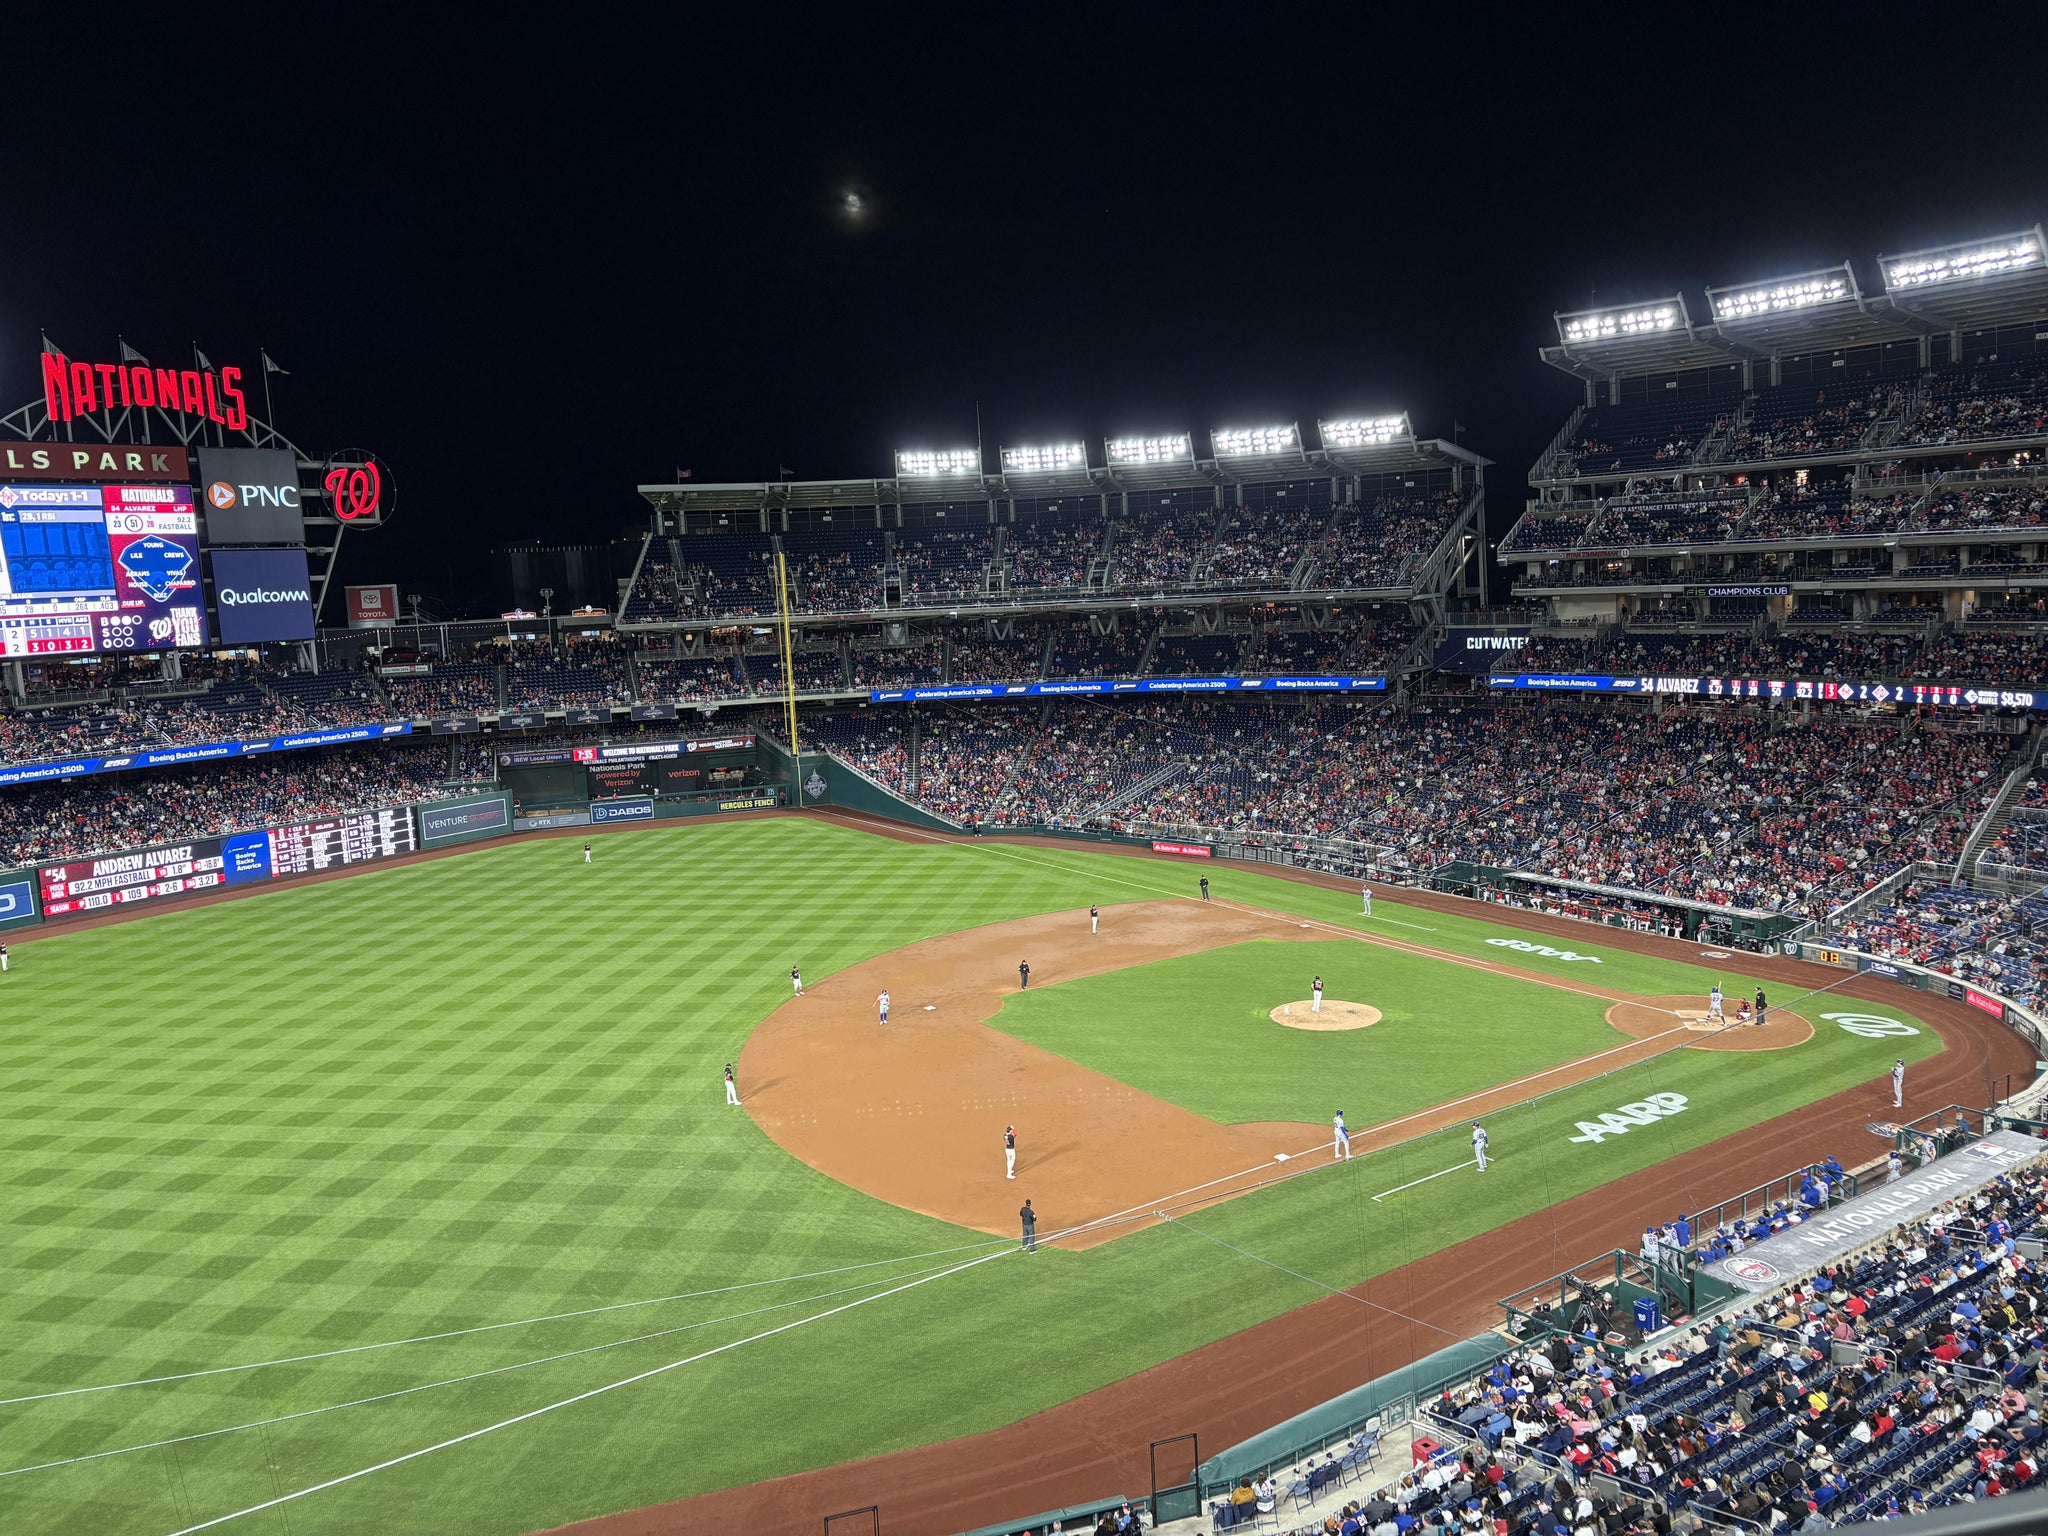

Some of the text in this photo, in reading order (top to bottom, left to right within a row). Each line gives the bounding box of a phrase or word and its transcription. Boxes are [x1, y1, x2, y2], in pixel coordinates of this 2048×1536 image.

[41, 352, 247, 430] NATIONALS
[72, 451, 170, 473] PARK
[20, 490, 88, 503] Today: 1-1
[121, 488, 175, 503] NATIONALS
[238, 485, 299, 508] PNC
[113, 520, 121, 528] 23
[130, 519, 138, 527] 51
[1708, 587, 1761, 596] CHAMPIONS
[1762, 586, 1788, 595] CLUB
[220, 588, 309, 606] Qualcomm
[100, 617, 109, 626] B
[30, 629, 37, 638] 5
[46, 628, 52, 637] 1
[63, 627, 70, 636] 4
[80, 627, 86, 635] 1
[102, 628, 110, 637] S
[13, 639, 88, 652] 2 3 0 3 2
[1466, 636, 1529, 650] CUTWATE
[1149, 682, 1182, 690] Celebrating
[1527, 678, 1550, 687] Boeing
[1570, 679, 1597, 687] America
[1641, 678, 1699, 693] 54 ALVAREZ
[915, 690, 948, 698] Celebrating
[1040, 686, 1061, 694] Boeing
[1708, 684, 1722, 694] 3.27
[1771, 687, 1782, 697] 50
[1796, 688, 1813, 698] 92.2
[1859, 685, 1867, 699] 2
[1895, 687, 1904, 700] 2
[1916, 693, 1923, 703] 2
[1932, 694, 1940, 704] 0
[1949, 694, 1957, 705] 0
[2001, 691, 2033, 707] $8,570
[283, 729, 369, 747] Celebrating America's 250th
[149, 746, 228, 763] Boeing Backs America
[602, 743, 680, 757] WELCOME TO NATIONALS PARK
[545, 753, 562, 761] Union
[20, 764, 85, 779] America's 250th
[589, 762, 646, 773] Nationals Park
[595, 769, 641, 780] powered by
[667, 769, 701, 779] verizon
[604, 778, 634, 787] Verizon
[720, 799, 775, 811] HERCULES FENCE
[608, 805, 652, 817] DABOS
[428, 814, 469, 829] VENTURE
[93, 854, 143, 877] ANDREW
[145, 846, 193, 867] ALVAREZ
[235, 852, 257, 860] Boeing
[236, 858, 254, 866] Backs
[236, 863, 262, 871] America
[45, 868, 67, 882] #54
[199, 875, 214, 886] 3.27
[74, 869, 151, 893] 92.2 MPH FASTBALL
[165, 881, 178, 892] 2-6
[128, 888, 142, 899] 109
[88, 895, 108, 907] 110.0
[1485, 938, 1603, 963] AARP
[1568, 1092, 1689, 1143] AARP
[1990, 1149, 2028, 1167] MLB
[1800, 1167, 1970, 1248] NATIONALS PARK
[1636, 1423, 1643, 1433] 5
